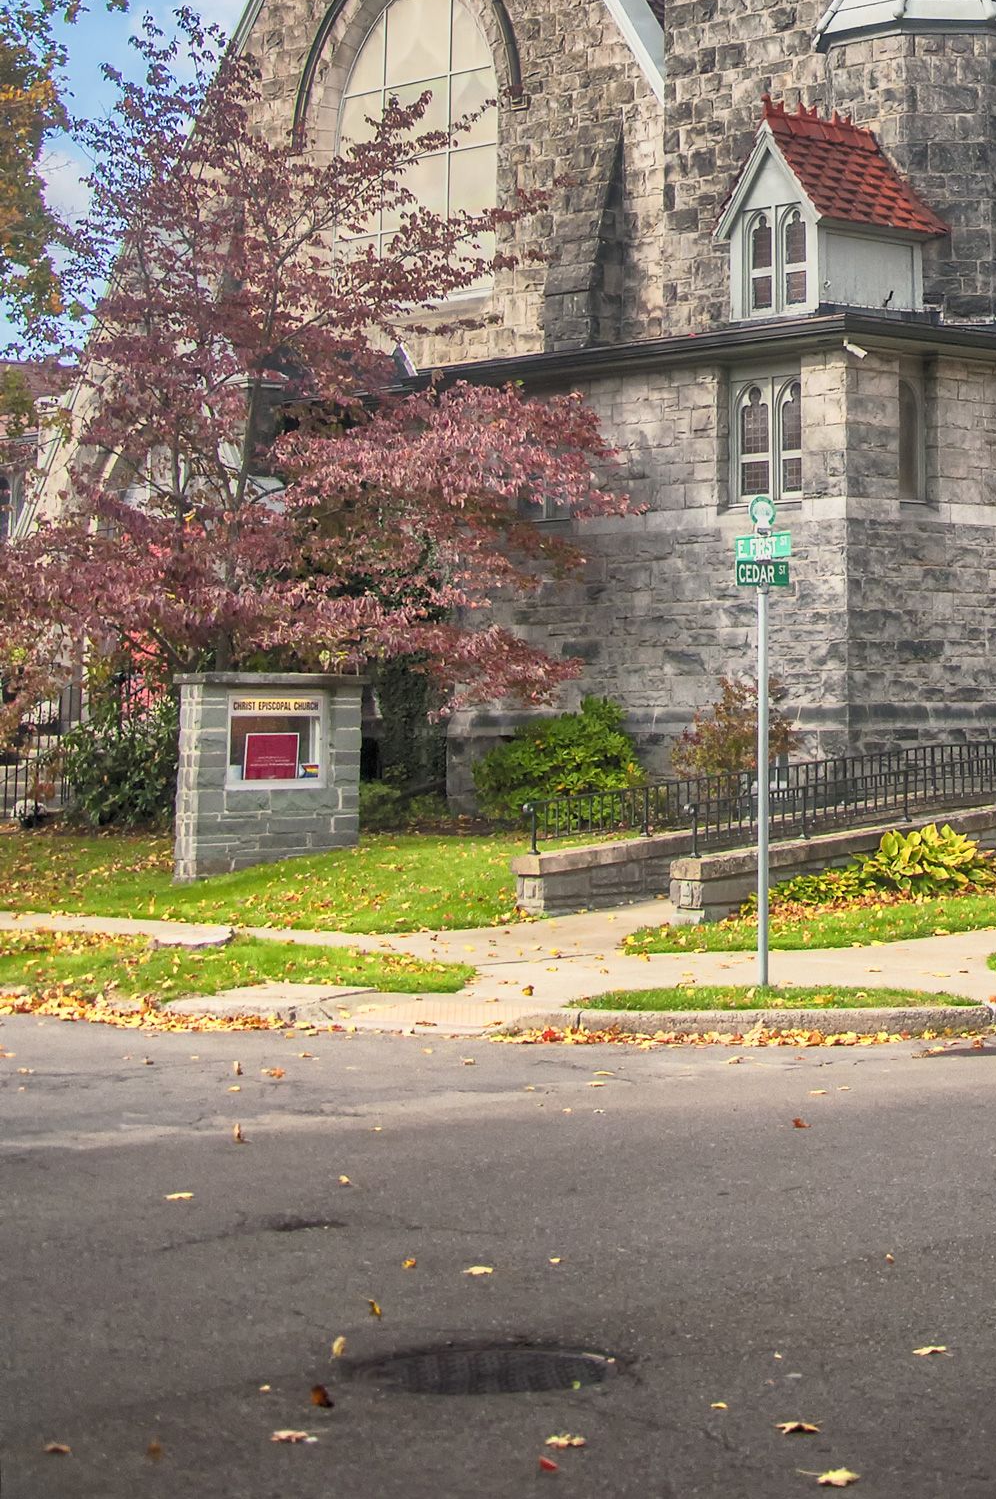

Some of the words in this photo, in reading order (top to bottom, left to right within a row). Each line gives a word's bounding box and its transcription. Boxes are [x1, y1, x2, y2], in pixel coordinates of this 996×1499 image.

[738, 540, 747, 558] E
[750, 537, 777, 557] FIRST
[779, 536, 788, 546] ST
[738, 564, 775, 583] CEDAR
[778, 565, 786, 575] ST
[233, 701, 256, 711] CHRIST
[258, 701, 291, 711] EPISCOPAL
[294, 701, 319, 711] CHURCH
